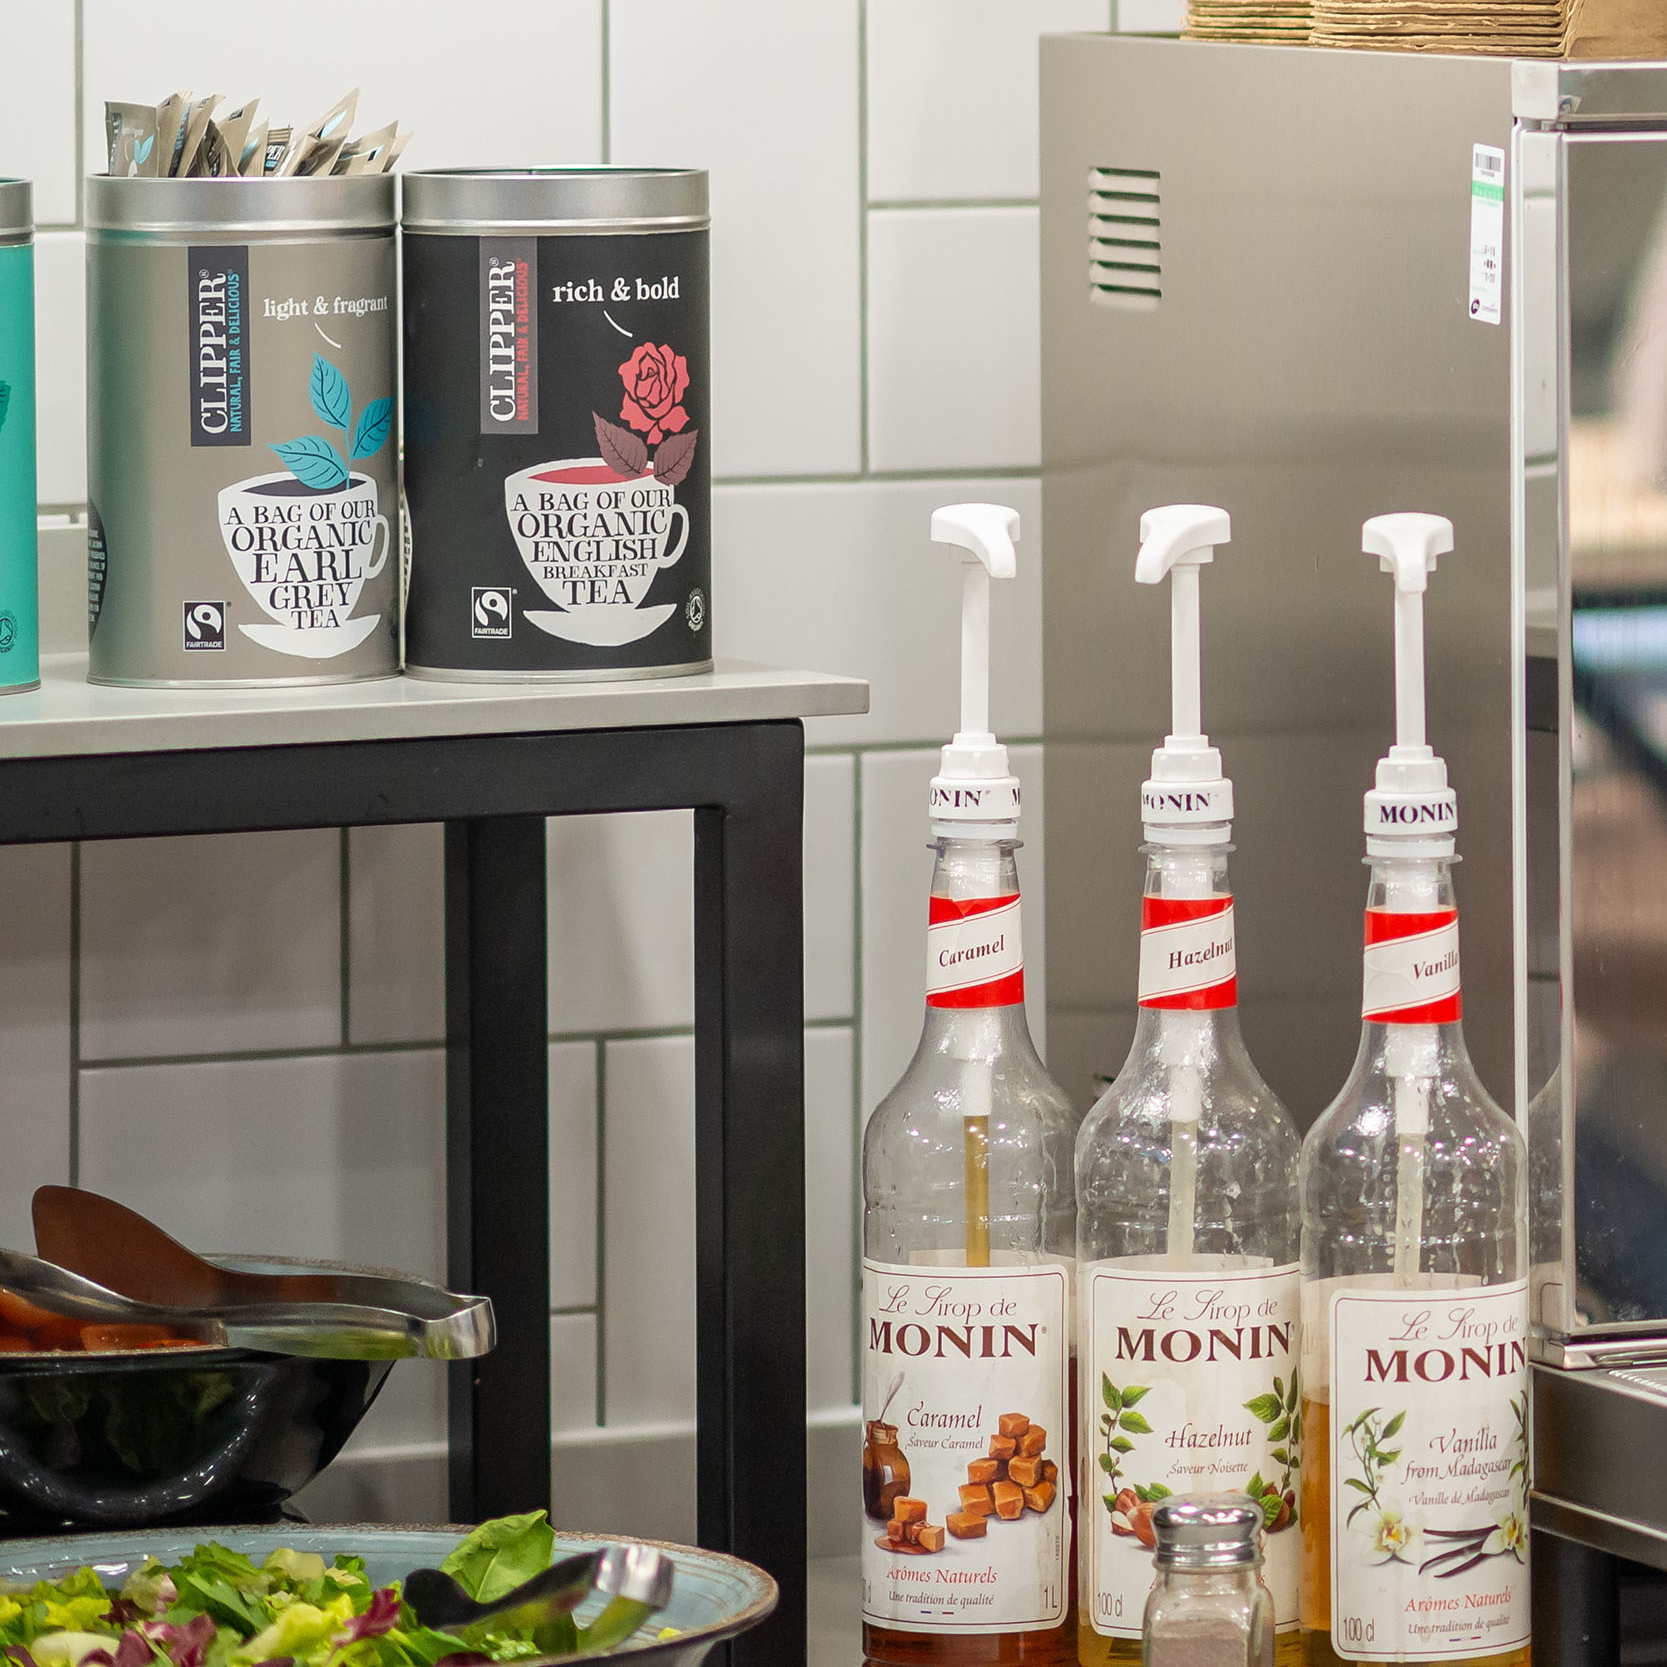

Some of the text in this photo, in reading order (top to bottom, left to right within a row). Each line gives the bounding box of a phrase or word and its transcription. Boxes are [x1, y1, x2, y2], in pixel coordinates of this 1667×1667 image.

[552, 276, 680, 302] rich & bold
[263, 295, 388, 321] light & fragrant
[198, 272, 228, 434] CLIPPER
[228, 273, 244, 432] NATURAL, FAIR & DELICIOUS
[489, 261, 516, 422] CLIPPER
[224, 499, 376, 525] A BAG OF OUR
[511, 489, 673, 511] A BAG OF OUR
[231, 520, 373, 551] ORGANIC
[517, 509, 667, 538] ORGANIC
[530, 538, 658, 562] ENGLISH
[250, 548, 362, 584] EARL
[543, 563, 648, 579] BREAKFAST
[269, 582, 353, 610] GREY
[562, 579, 634, 605] TEA
[291, 609, 341, 630] TEA
[475, 627, 508, 635] FAIRTRADE
[939, 934, 1004, 967] Caramel
[879, 1284, 1017, 1325] Le Sirop de
[1137, 1289, 1278, 1327] Le Sirop de
[869, 1317, 1039, 1359] MONIN
[1389, 1308, 1518, 1343] Le Sirop de
[1115, 1321, 1291, 1363] MONIN
[1363, 1337, 1526, 1383] MONIN
[907, 1401, 982, 1429] Caramel
[905, 1432, 984, 1450] Saveur Caramel
[1165, 1422, 1252, 1449] Hazelnut
[1429, 1428, 1497, 1454] Vanilla
[1166, 1459, 1248, 1478] Saveur Noisette
[1401, 1454, 1512, 1485] from Madagascar
[1408, 1488, 1511, 1505] Vanille de Madagascar
[886, 1565, 998, 1584] Arômes Naturels
[888, 1591, 903, 1602] Une
[905, 1590, 944, 1605] tradition
[947, 1591, 958, 1605] de
[960, 1592, 995, 1609] qualité
[1404, 1586, 1511, 1613] Arômes Naturels
[1343, 1618, 1375, 1642] 100 cl
[1408, 1623, 1429, 1634] Une
[1429, 1620, 1472, 1634] tradition
[1474, 1617, 1483, 1630] de
